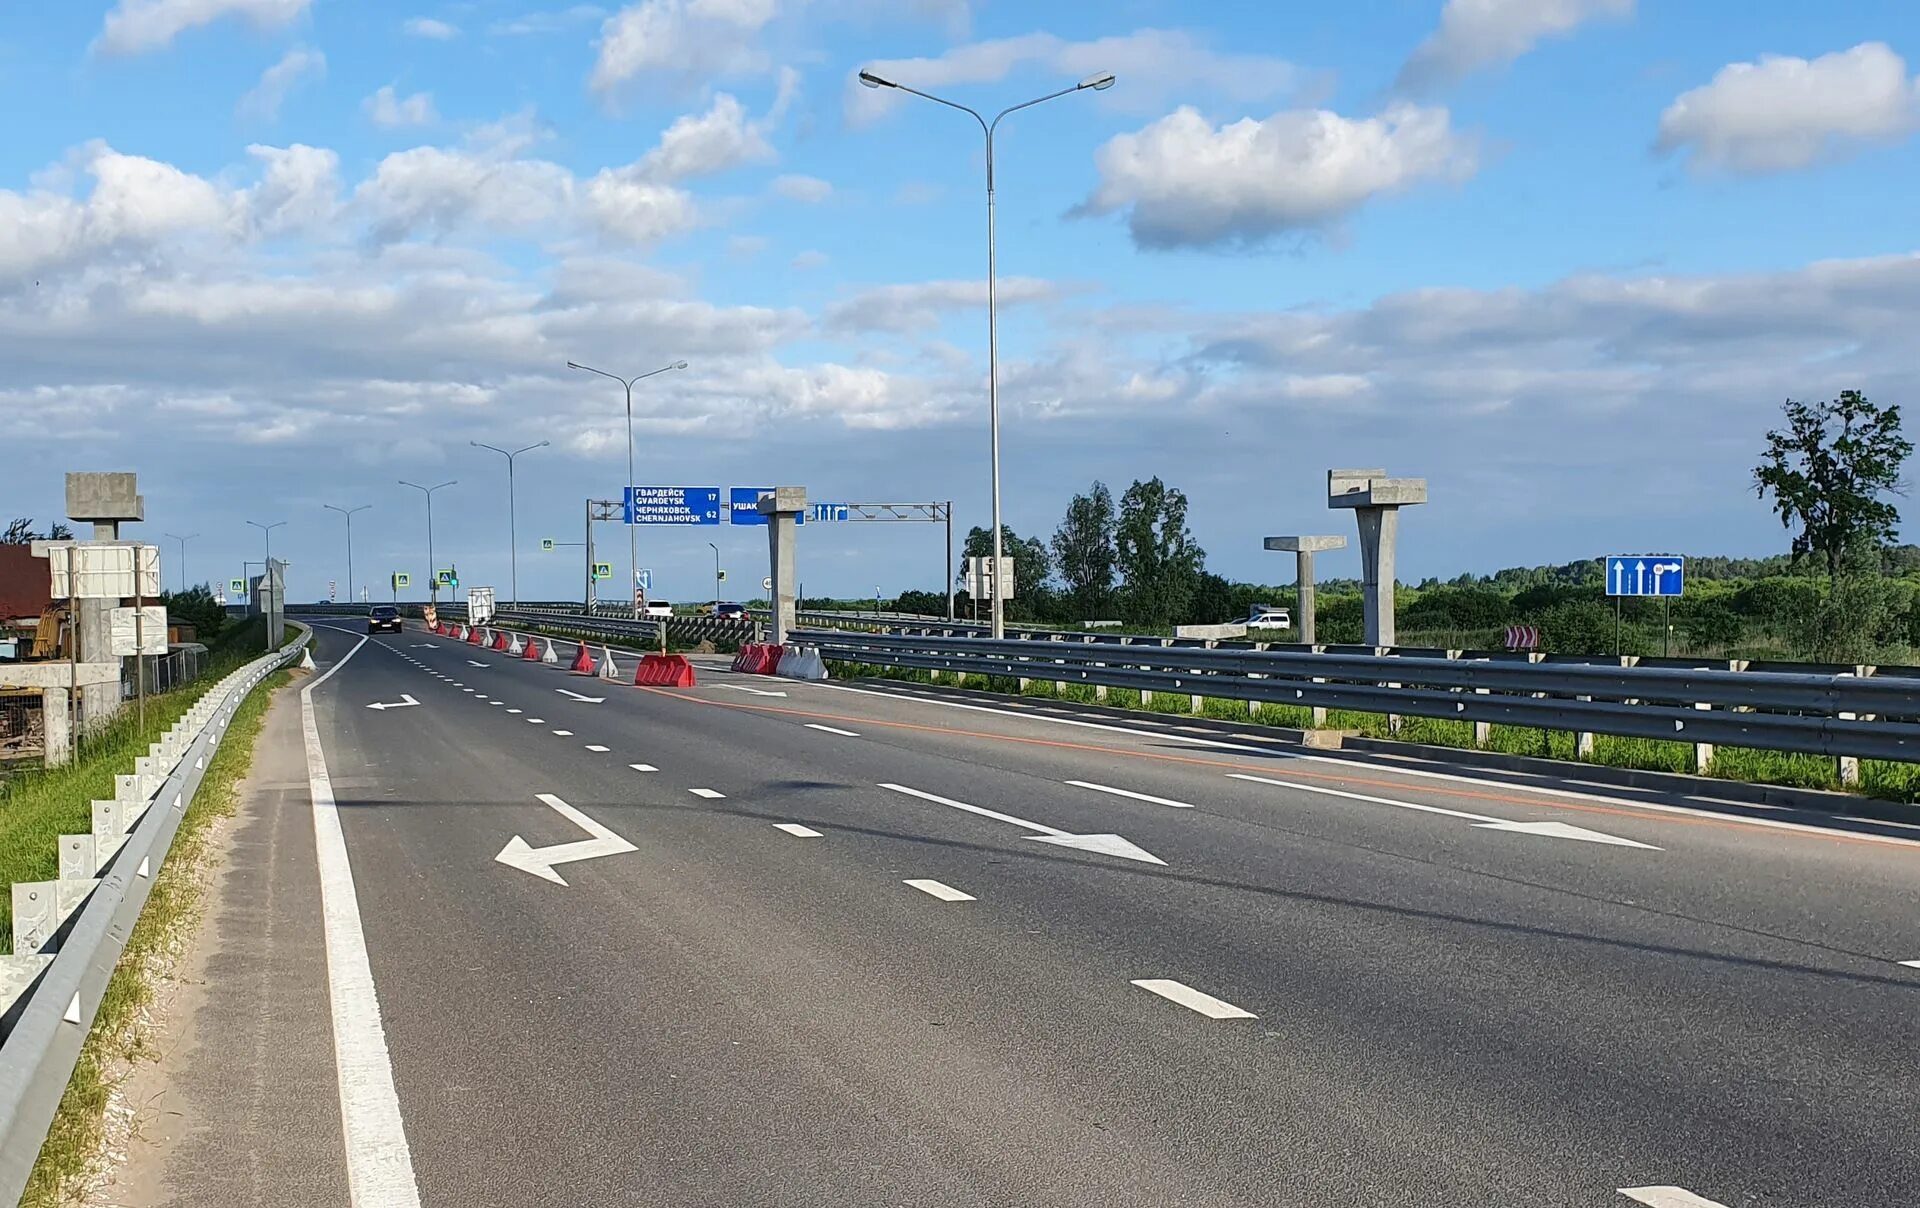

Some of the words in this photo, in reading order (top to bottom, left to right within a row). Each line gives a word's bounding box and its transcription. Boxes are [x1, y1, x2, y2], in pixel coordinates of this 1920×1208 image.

[635, 488, 685, 497] ГВАРДЕЙСК
[636, 497, 685, 505] GVARDEYSK
[708, 493, 716, 501] 17
[636, 506, 691, 514] ЧЕРНЯХОВСК
[733, 502, 758, 510] УШАК
[636, 514, 701, 523] CHERNJAHOVSK
